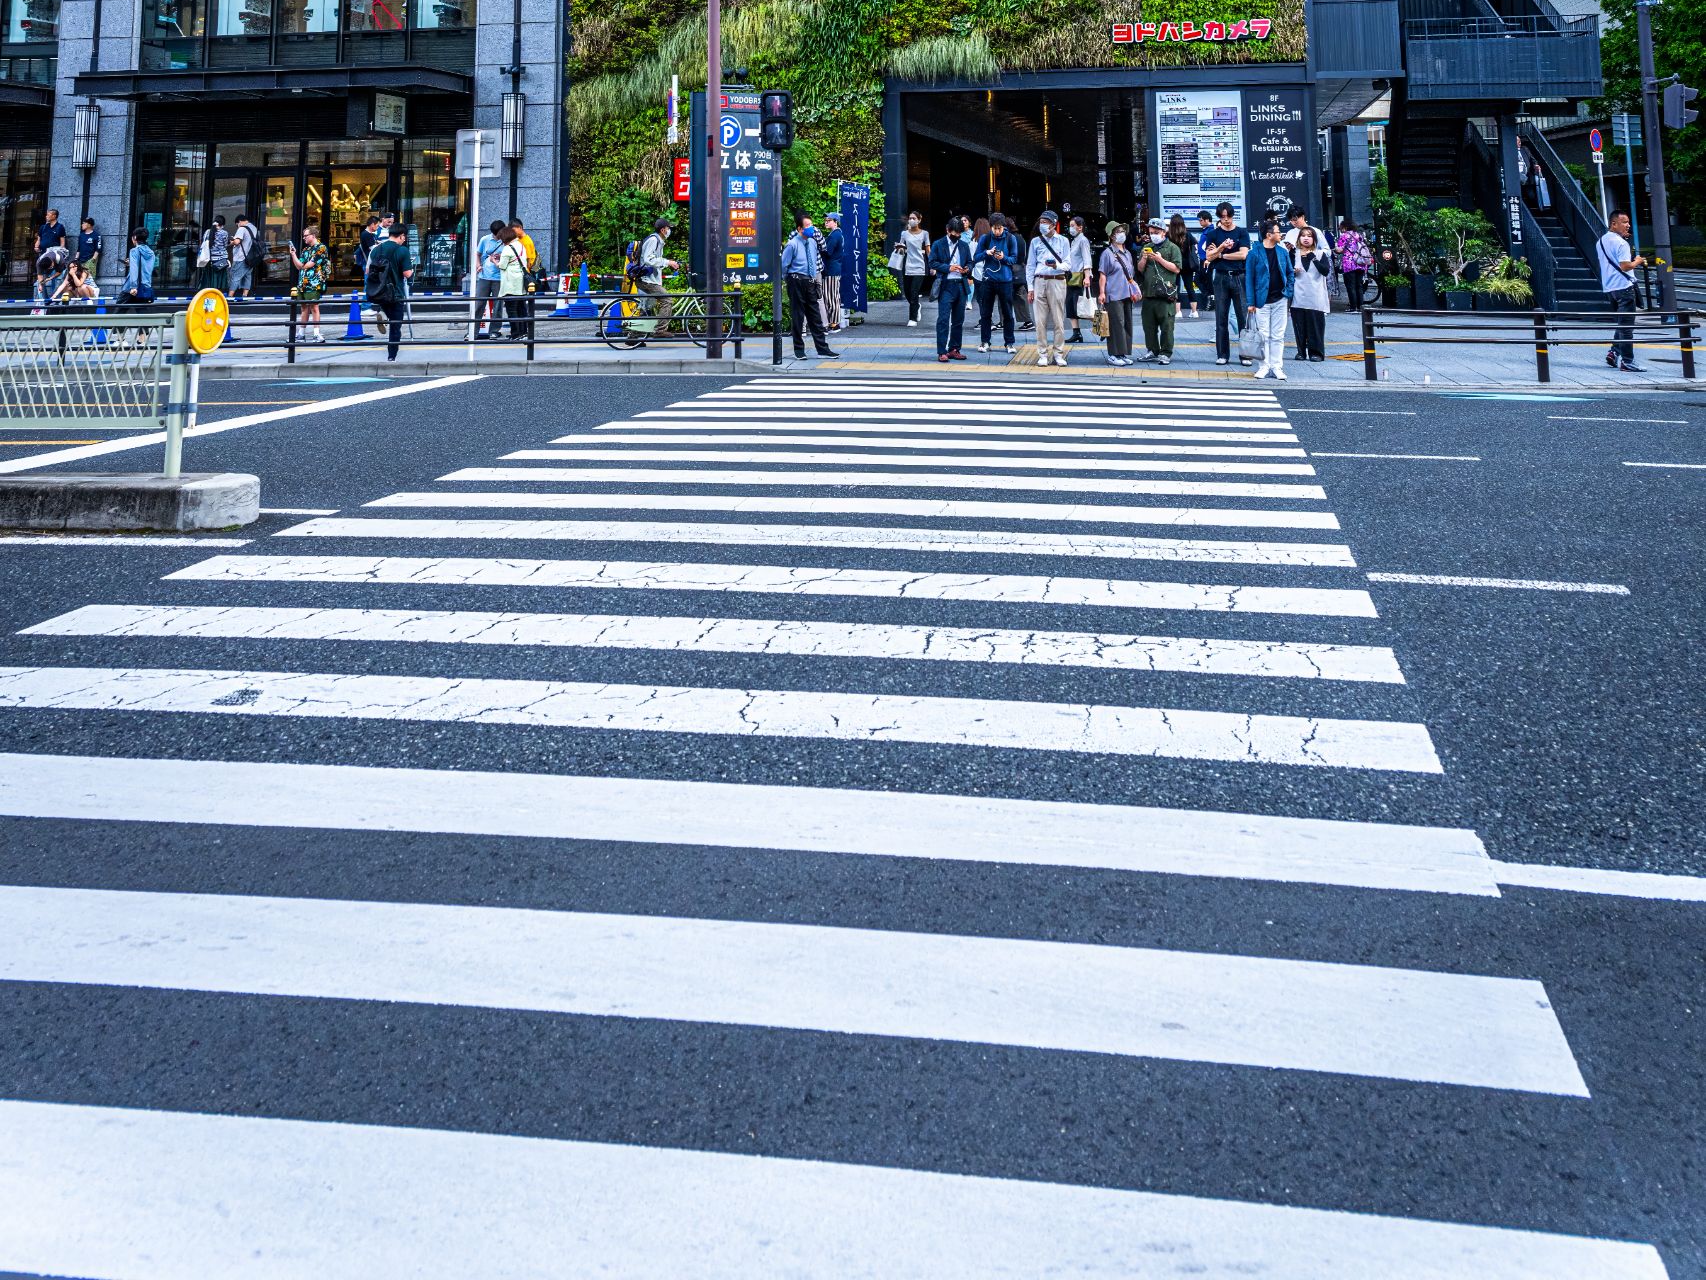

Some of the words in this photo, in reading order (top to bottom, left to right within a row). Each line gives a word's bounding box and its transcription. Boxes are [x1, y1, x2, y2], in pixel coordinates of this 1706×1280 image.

[1112, 19, 1271, 43] ヨドバシカメラ
[729, 95, 761, 104] YODOBAS
[1269, 94, 1279, 102] 8F
[1250, 104, 1286, 113] LINKS
[1250, 114, 1291, 122] DINING
[723, 126, 734, 145] P
[1260, 137, 1280, 145] Cafe
[1282, 137, 1290, 145] &
[1251, 144, 1302, 152] Restaurants
[730, 180, 756, 195] 空車
